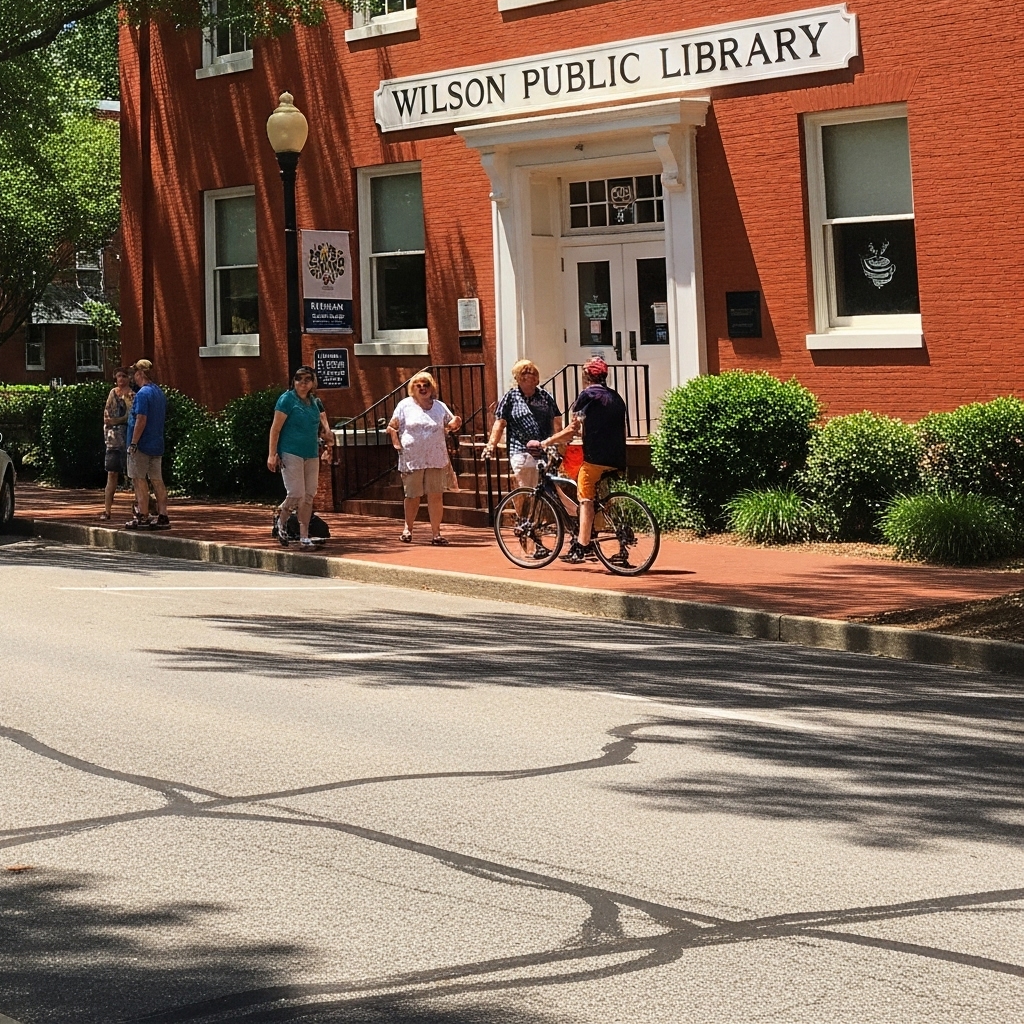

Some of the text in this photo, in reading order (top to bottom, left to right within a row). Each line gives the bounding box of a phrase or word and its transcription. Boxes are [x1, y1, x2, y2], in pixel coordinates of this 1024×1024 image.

[392, 21, 828, 118] WILSON PUBLIC LIBRARY
